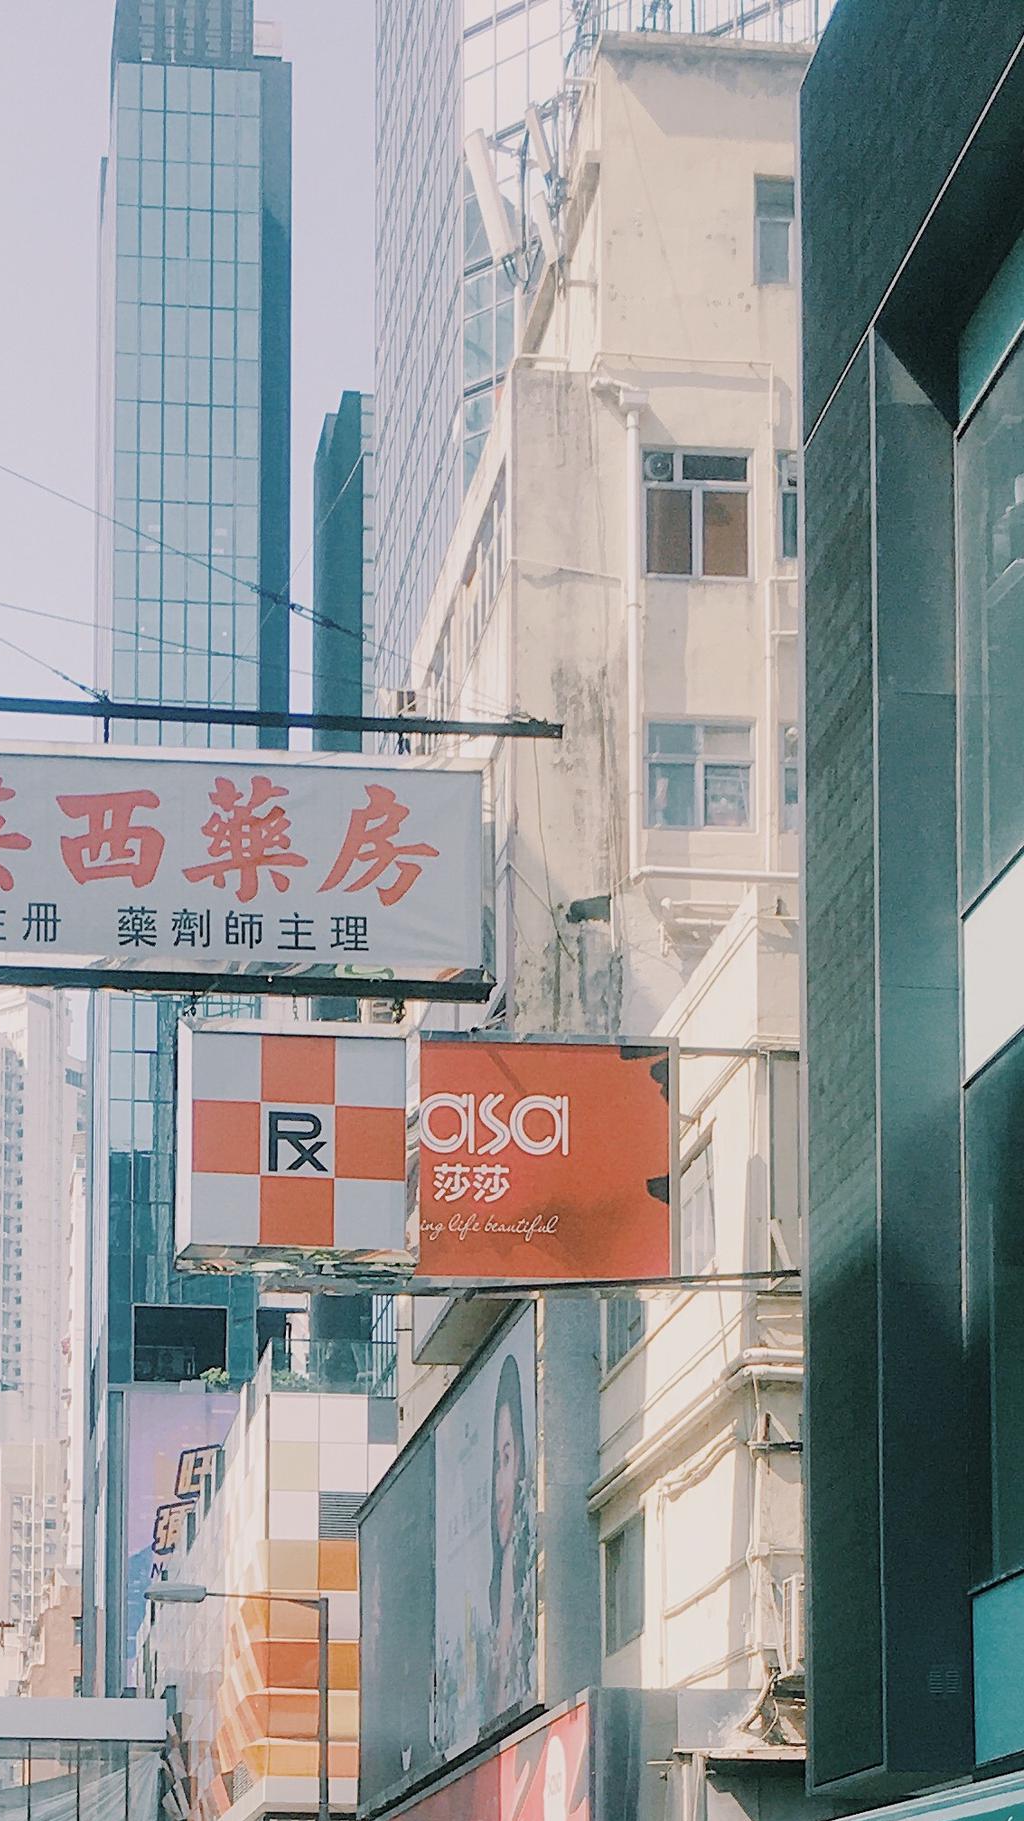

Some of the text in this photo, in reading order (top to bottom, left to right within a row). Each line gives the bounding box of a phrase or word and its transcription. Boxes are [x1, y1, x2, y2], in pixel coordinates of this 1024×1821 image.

[117, 906, 371, 953] 藥劑師主理
[433, 1163, 511, 1203] 莎莎
[448, 1213, 481, 1241] life
[484, 1213, 560, 1242] beautiful
